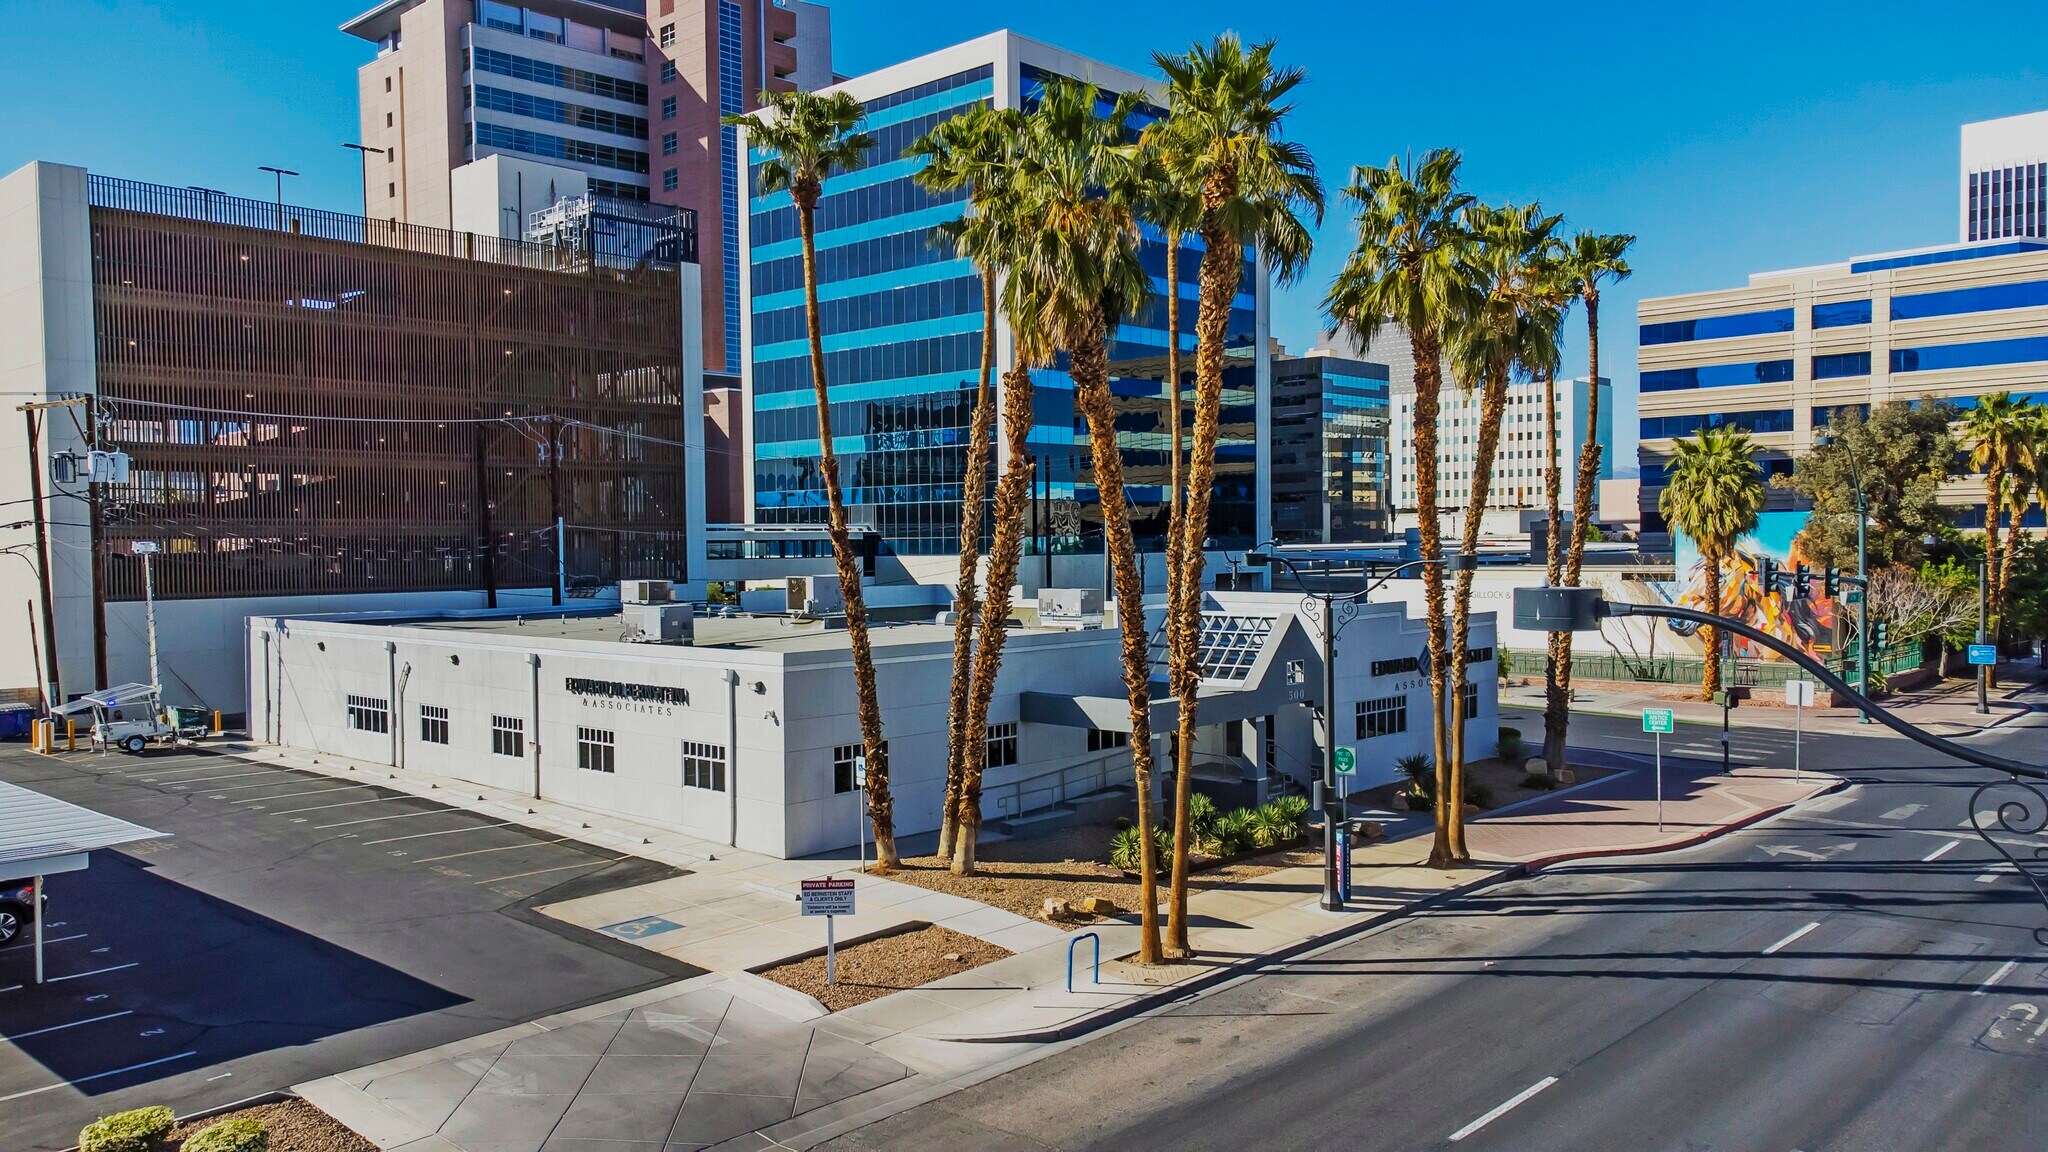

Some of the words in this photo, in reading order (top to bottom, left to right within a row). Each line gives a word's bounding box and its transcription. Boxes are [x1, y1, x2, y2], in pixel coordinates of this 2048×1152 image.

[1371, 656, 1418, 677] EDWARD
[1288, 689, 1304, 700] 500
[582, 698, 588, 706] &
[592, 700, 672, 716] ASSOCIATES
[140, 1028, 165, 1037] 2
